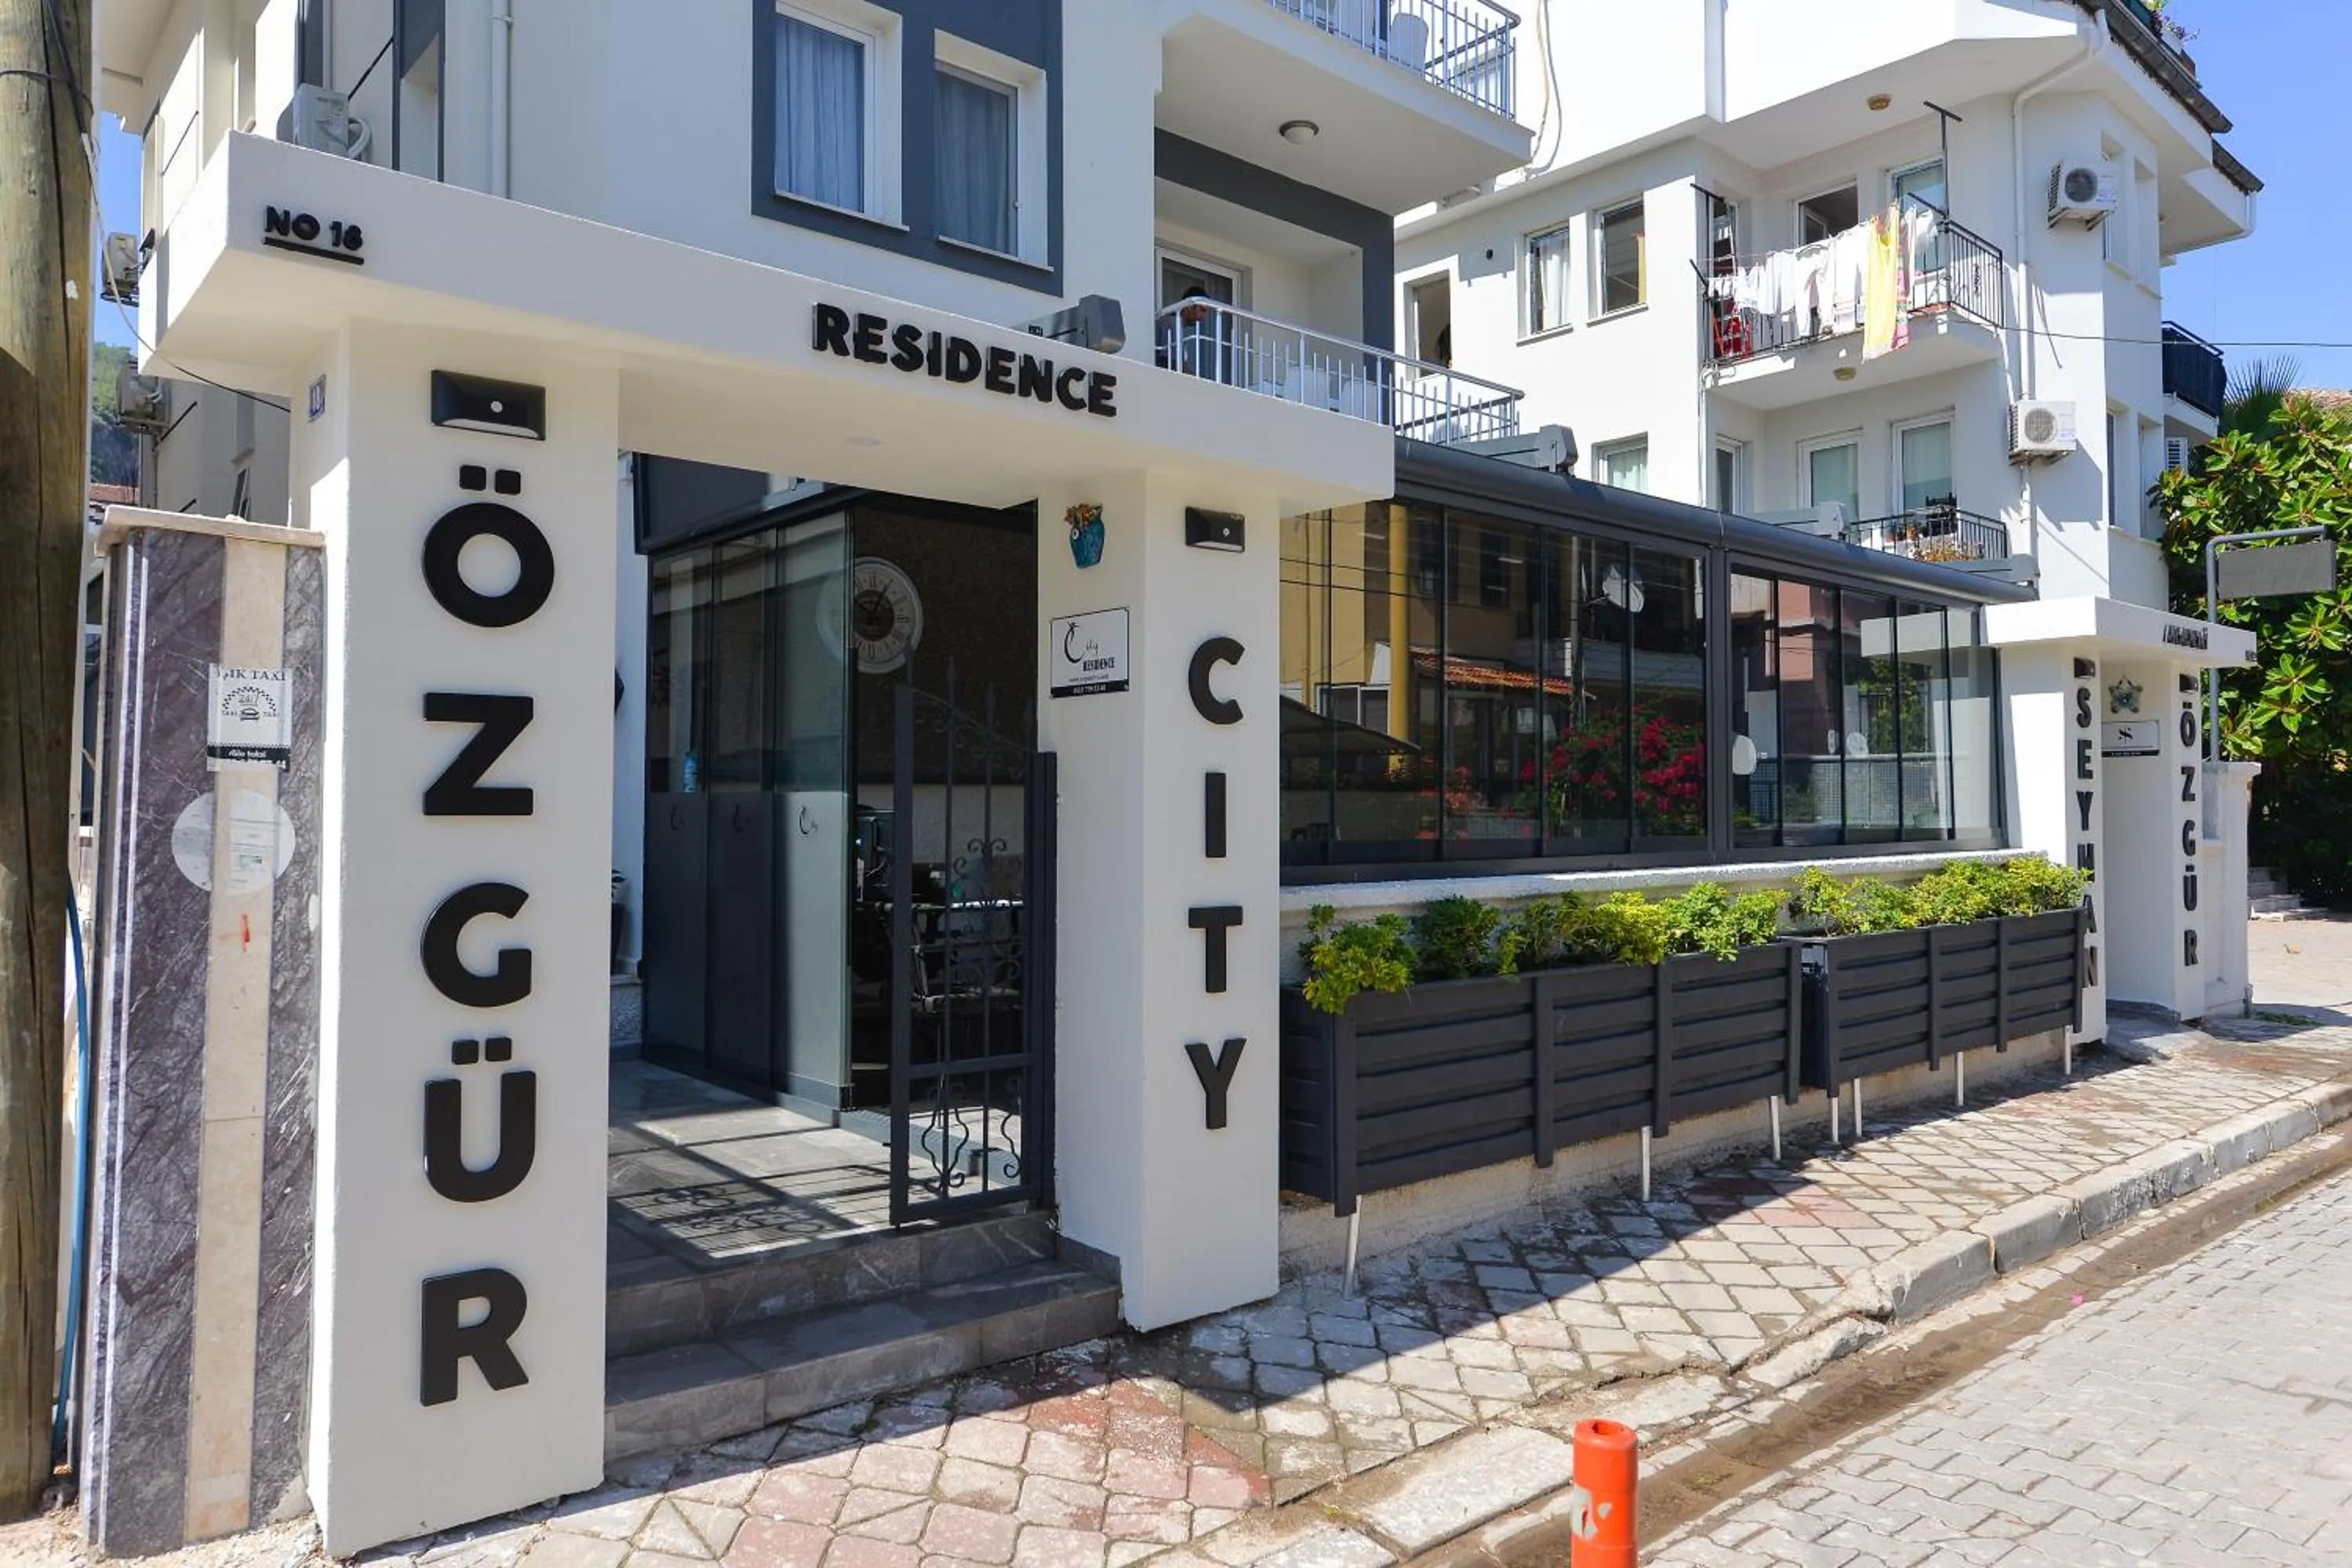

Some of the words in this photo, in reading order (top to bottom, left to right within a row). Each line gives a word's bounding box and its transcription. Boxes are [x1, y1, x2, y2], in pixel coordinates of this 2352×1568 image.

[263, 205, 321, 241] NO
[812, 302, 1117, 417] RESIDENCE
[250, 670, 285, 681] TAXI
[1184, 636, 1247, 1130] CITY
[2180, 702, 2199, 967] ÖZGÜR
[420, 464, 555, 1406] ÖZGÜR
